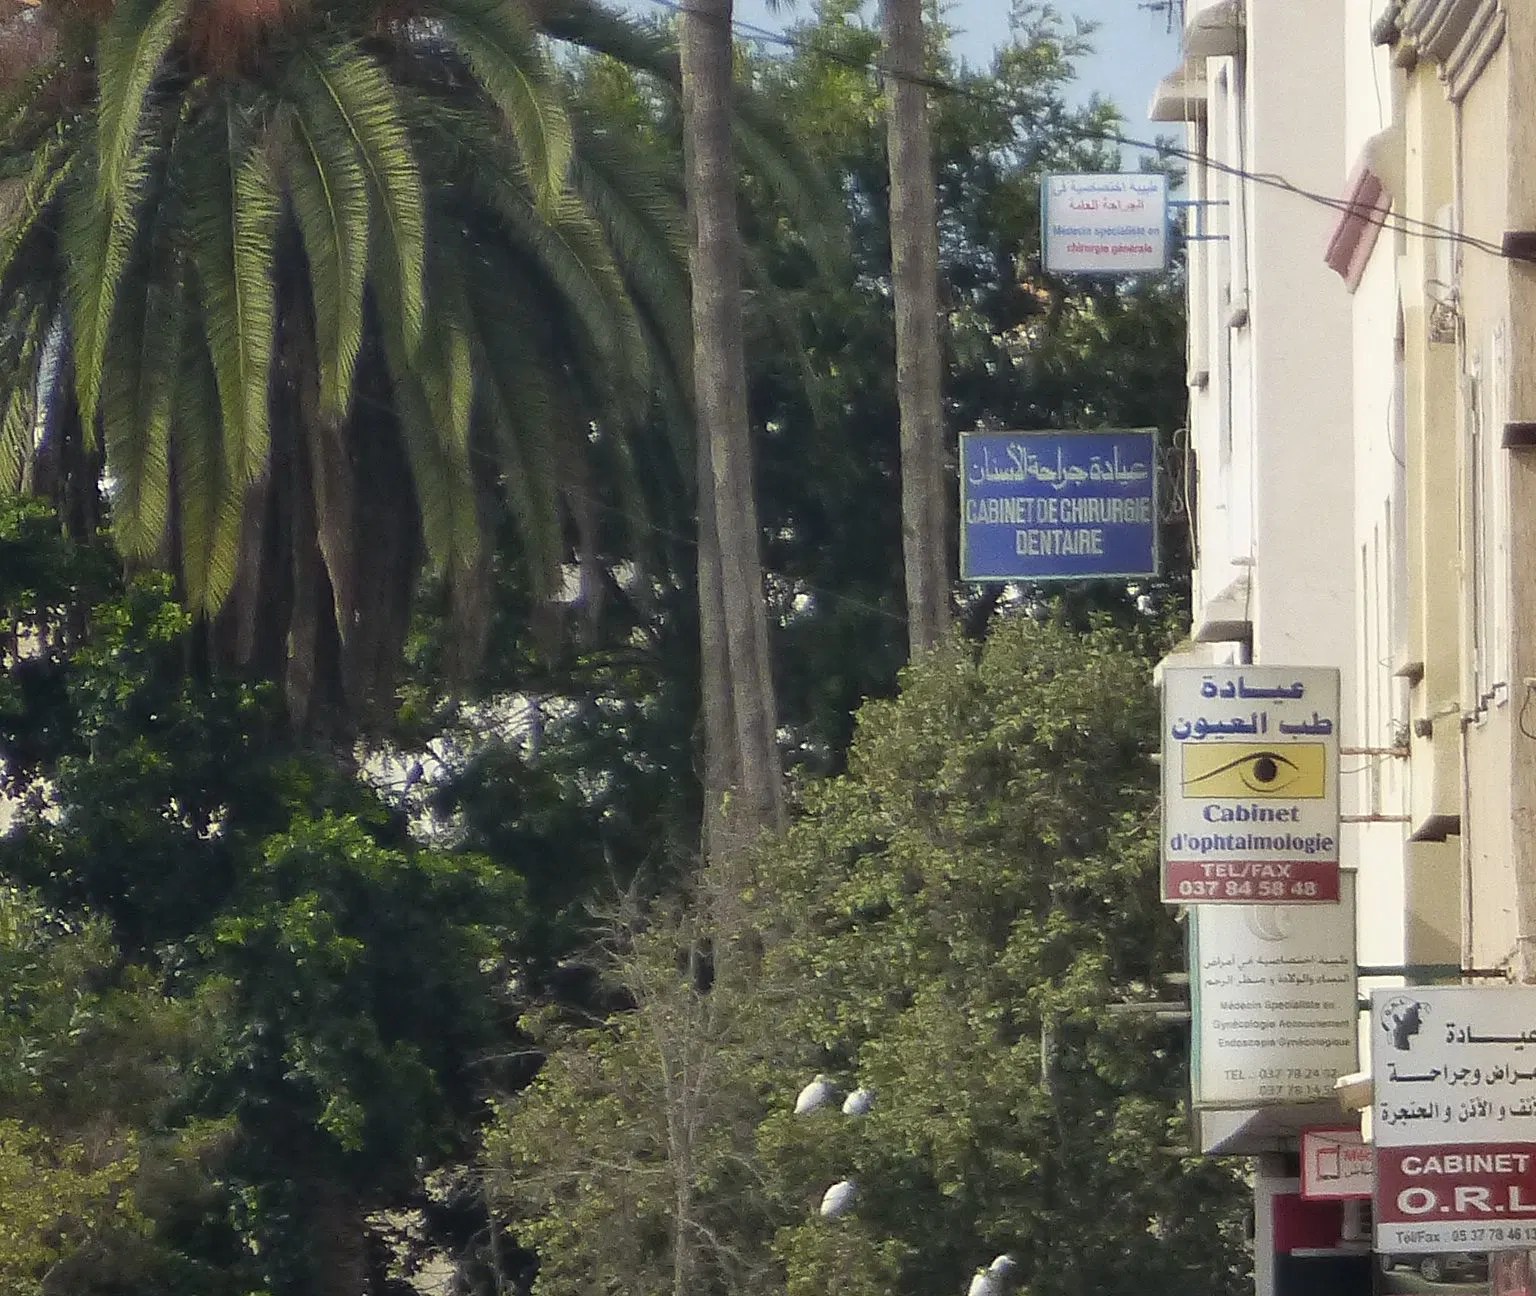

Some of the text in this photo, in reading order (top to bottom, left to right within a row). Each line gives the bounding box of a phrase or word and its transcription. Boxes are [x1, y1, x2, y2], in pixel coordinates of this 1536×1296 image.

[1027, 446, 1088, 490] جراحة
[1090, 445, 1149, 487] عيادة
[966, 497, 1034, 524] CABINET
[1036, 497, 1058, 523] DE
[1015, 529, 1104, 556] DENTAIRE
[1200, 675, 1304, 704] عيادة
[1171, 712, 1333, 740] طب العيون
[1203, 804, 1300, 823] Cabinet
[1170, 833, 1334, 853] d'ophtalmologie
[1201, 863, 1291, 878] TEL/FAX
[1179, 881, 1219, 896] 037
[1225, 881, 1250, 895] 84
[1400, 1154, 1530, 1176] CABINET
